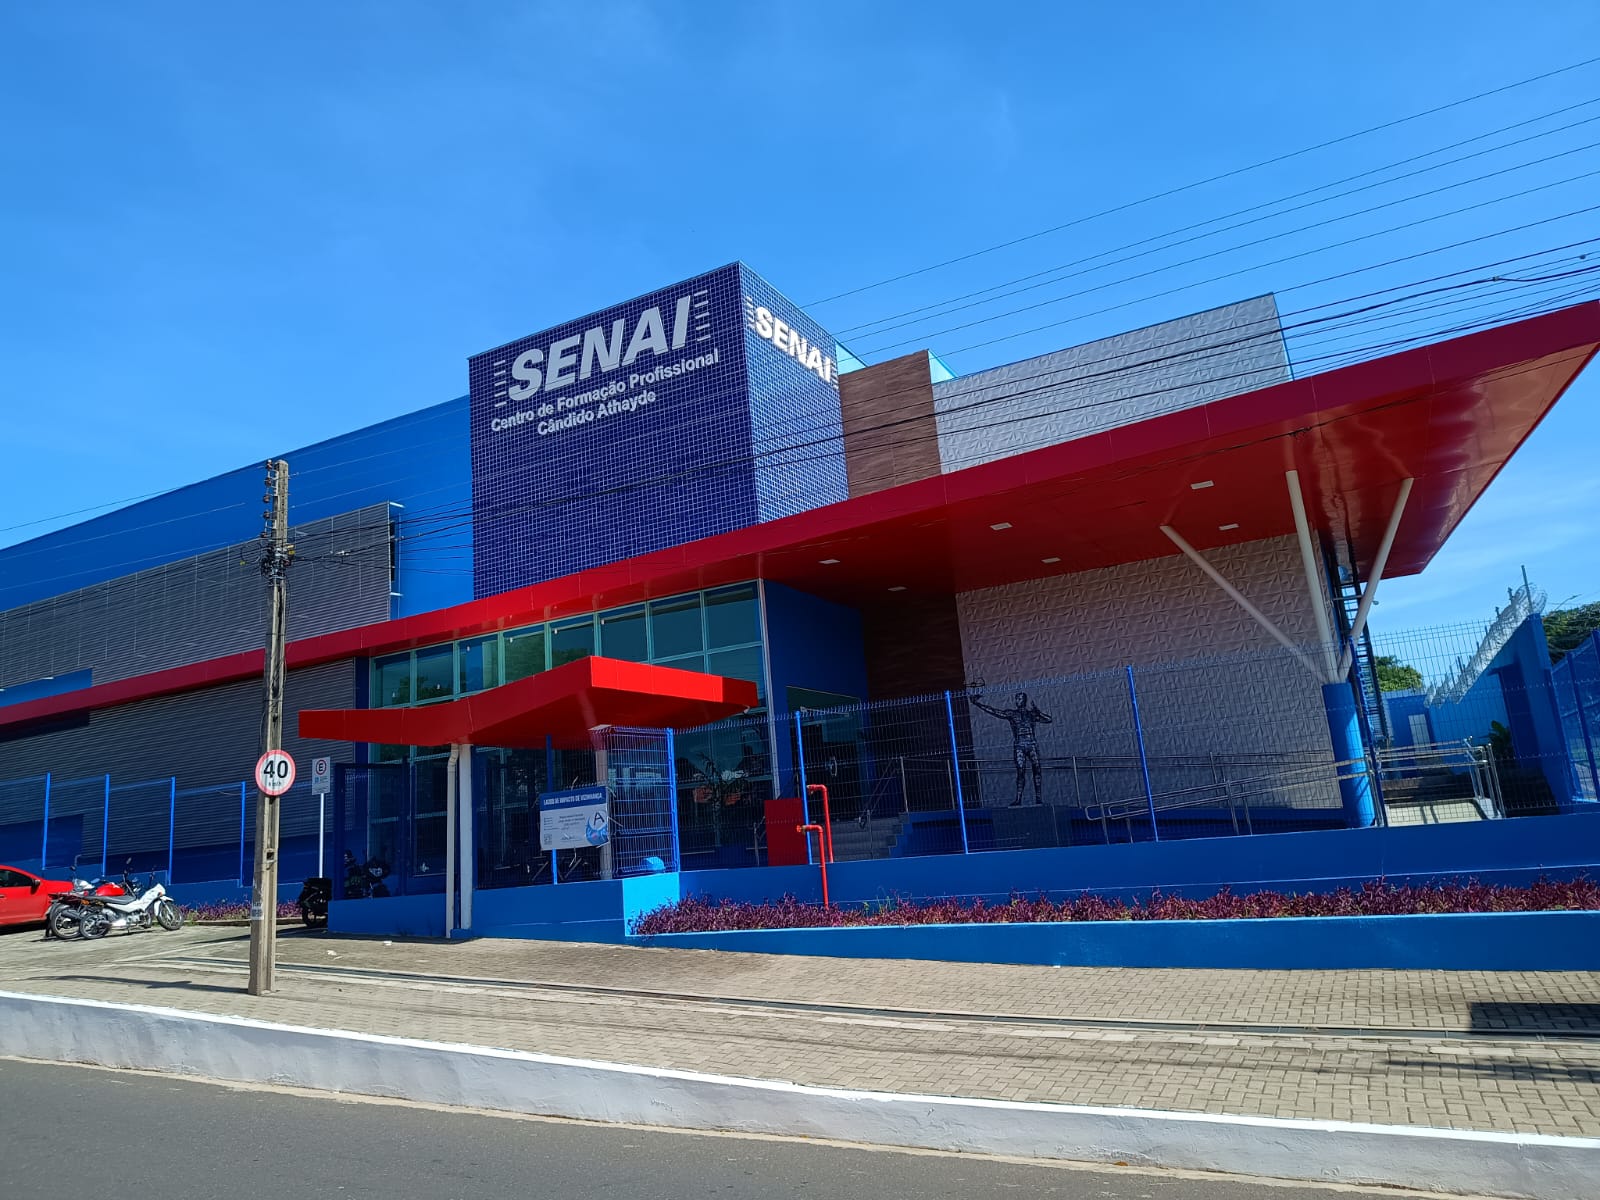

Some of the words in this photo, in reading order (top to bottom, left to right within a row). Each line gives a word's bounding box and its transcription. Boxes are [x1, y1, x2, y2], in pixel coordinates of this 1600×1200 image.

[508, 295, 691, 401] SENAI
[756, 306, 831, 383] SENAI
[491, 408, 534, 432] Centro
[537, 402, 554, 418] de
[557, 381, 626, 412] Formação
[629, 348, 719, 389] Profissional
[537, 408, 594, 436] Cândido
[597, 389, 656, 420] Athayde
[263, 760, 289, 779] 40
[318, 762, 324, 772] E
[593, 812, 605, 826] A
